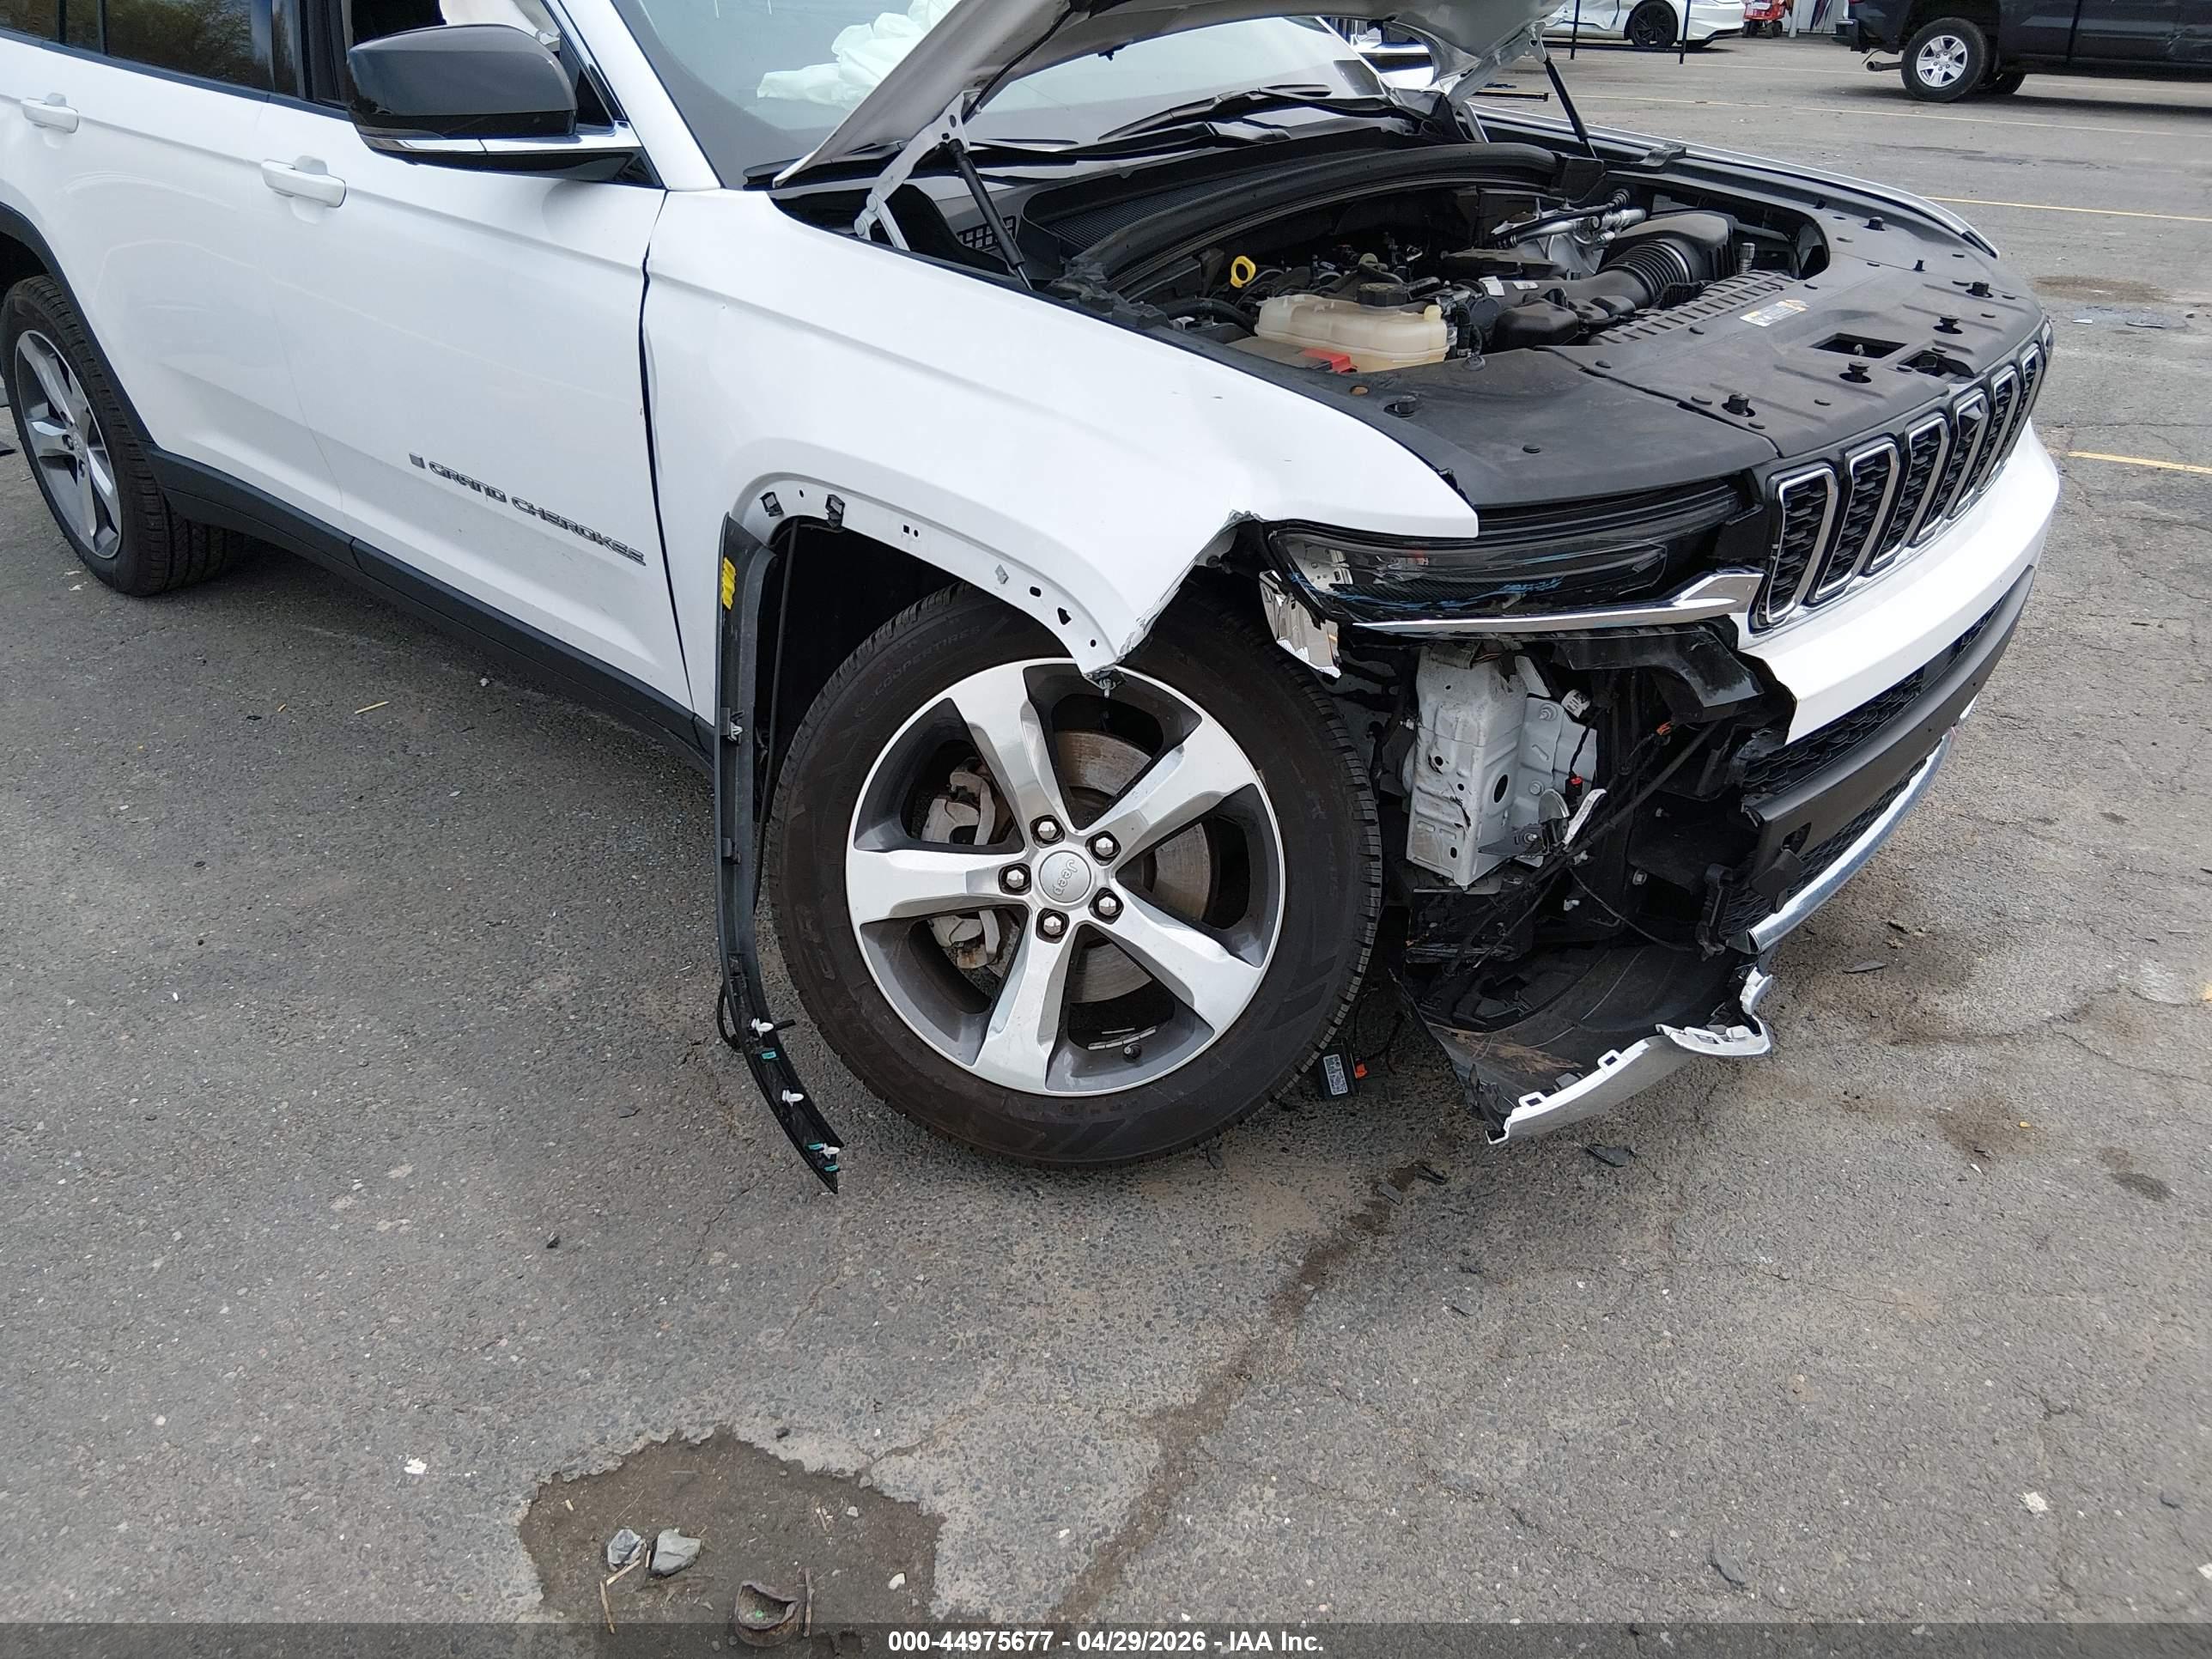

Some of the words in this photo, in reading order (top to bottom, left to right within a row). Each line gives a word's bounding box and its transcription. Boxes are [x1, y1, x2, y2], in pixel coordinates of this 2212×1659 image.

[428, 460, 507, 502] GRAND
[511, 496, 647, 565] CHEROKEE
[1053, 860, 1078, 895] Jeep
